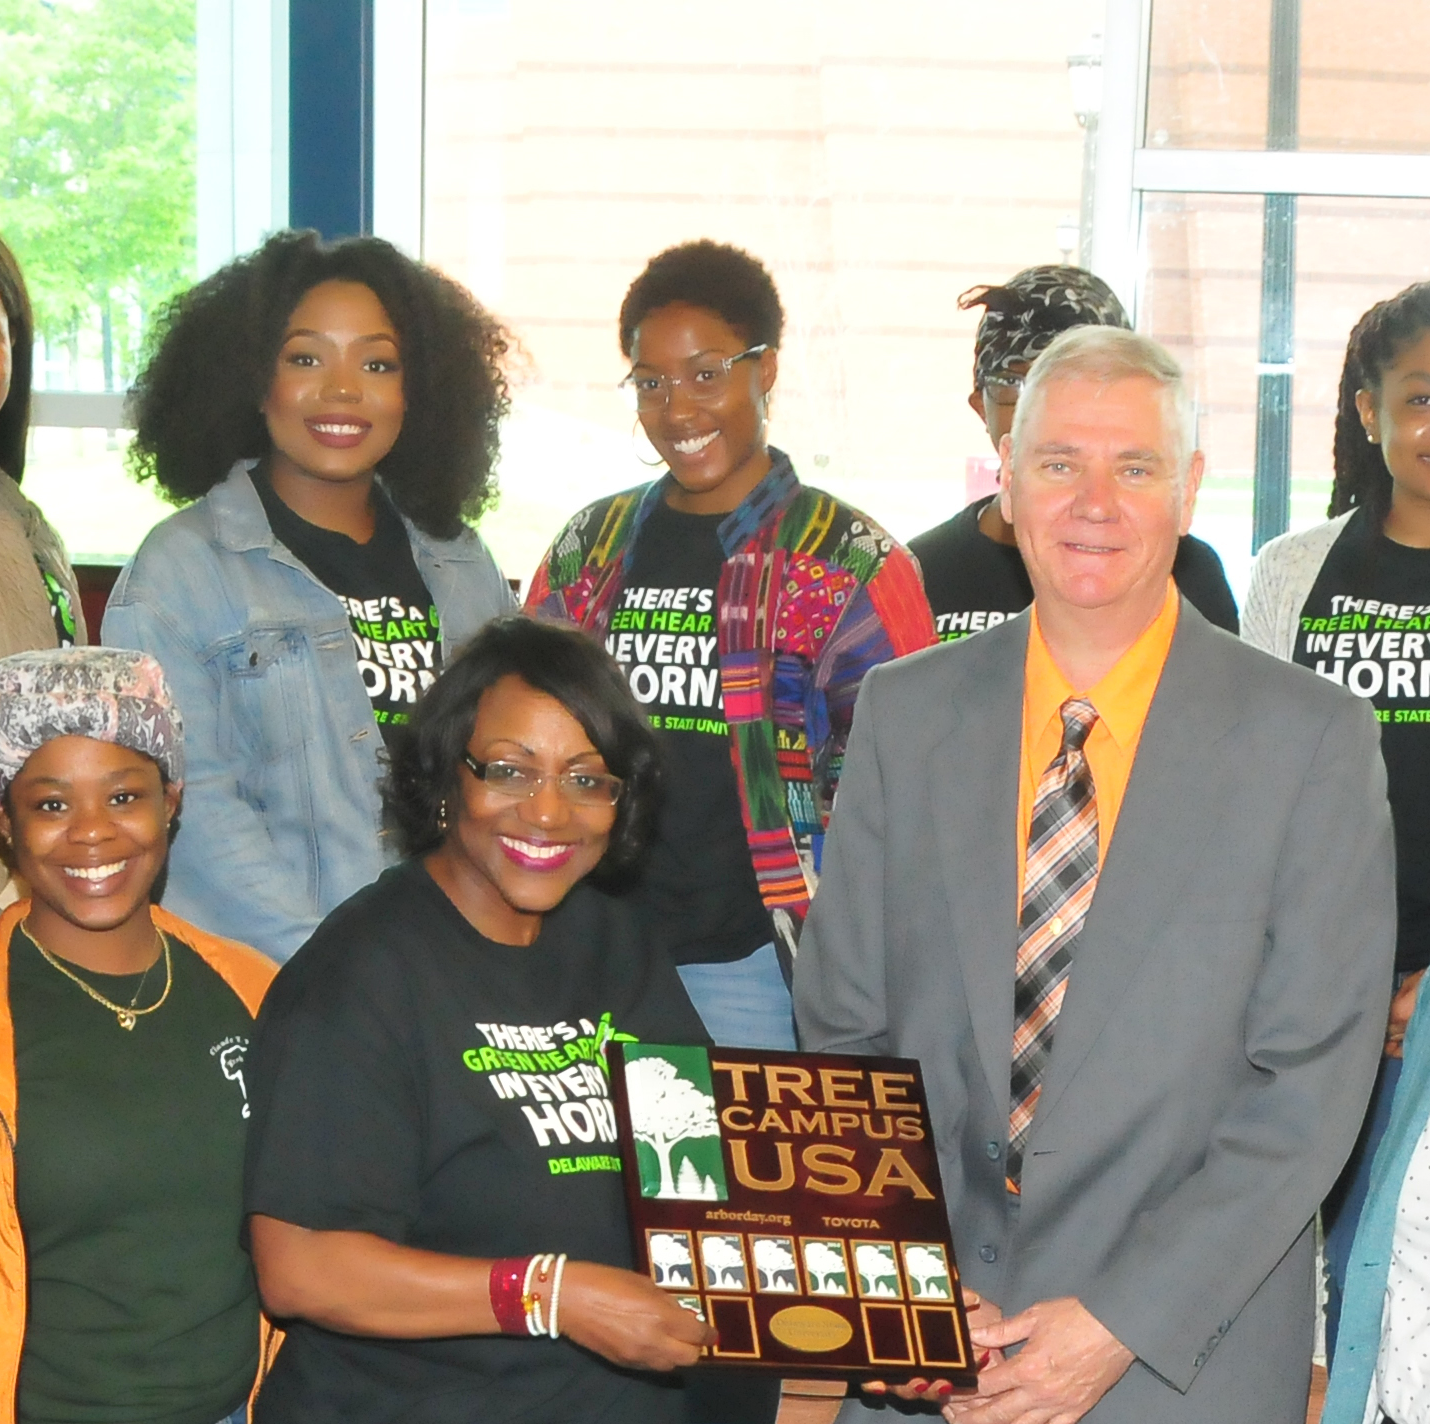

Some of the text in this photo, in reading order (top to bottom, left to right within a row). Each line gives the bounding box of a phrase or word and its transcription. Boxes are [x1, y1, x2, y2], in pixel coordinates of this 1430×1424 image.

[408, 605, 425, 621] A
[618, 587, 714, 613] HERE'S
[355, 619, 428, 641] HEART
[650, 611, 716, 632] HEAR
[615, 633, 717, 666] EVERY
[1306, 633, 1334, 653] IN
[475, 1018, 596, 1051] THERE'S A
[462, 1046, 537, 1072] GREEN
[488, 1063, 608, 1102] IN EVERY
[712, 1061, 920, 1113] TREE
[721, 1106, 925, 1141] CAMPUS
[728, 1139, 935, 1200] USA
[706, 1209, 791, 1226] arborday.org
[822, 1216, 880, 1229] TOYOTA
